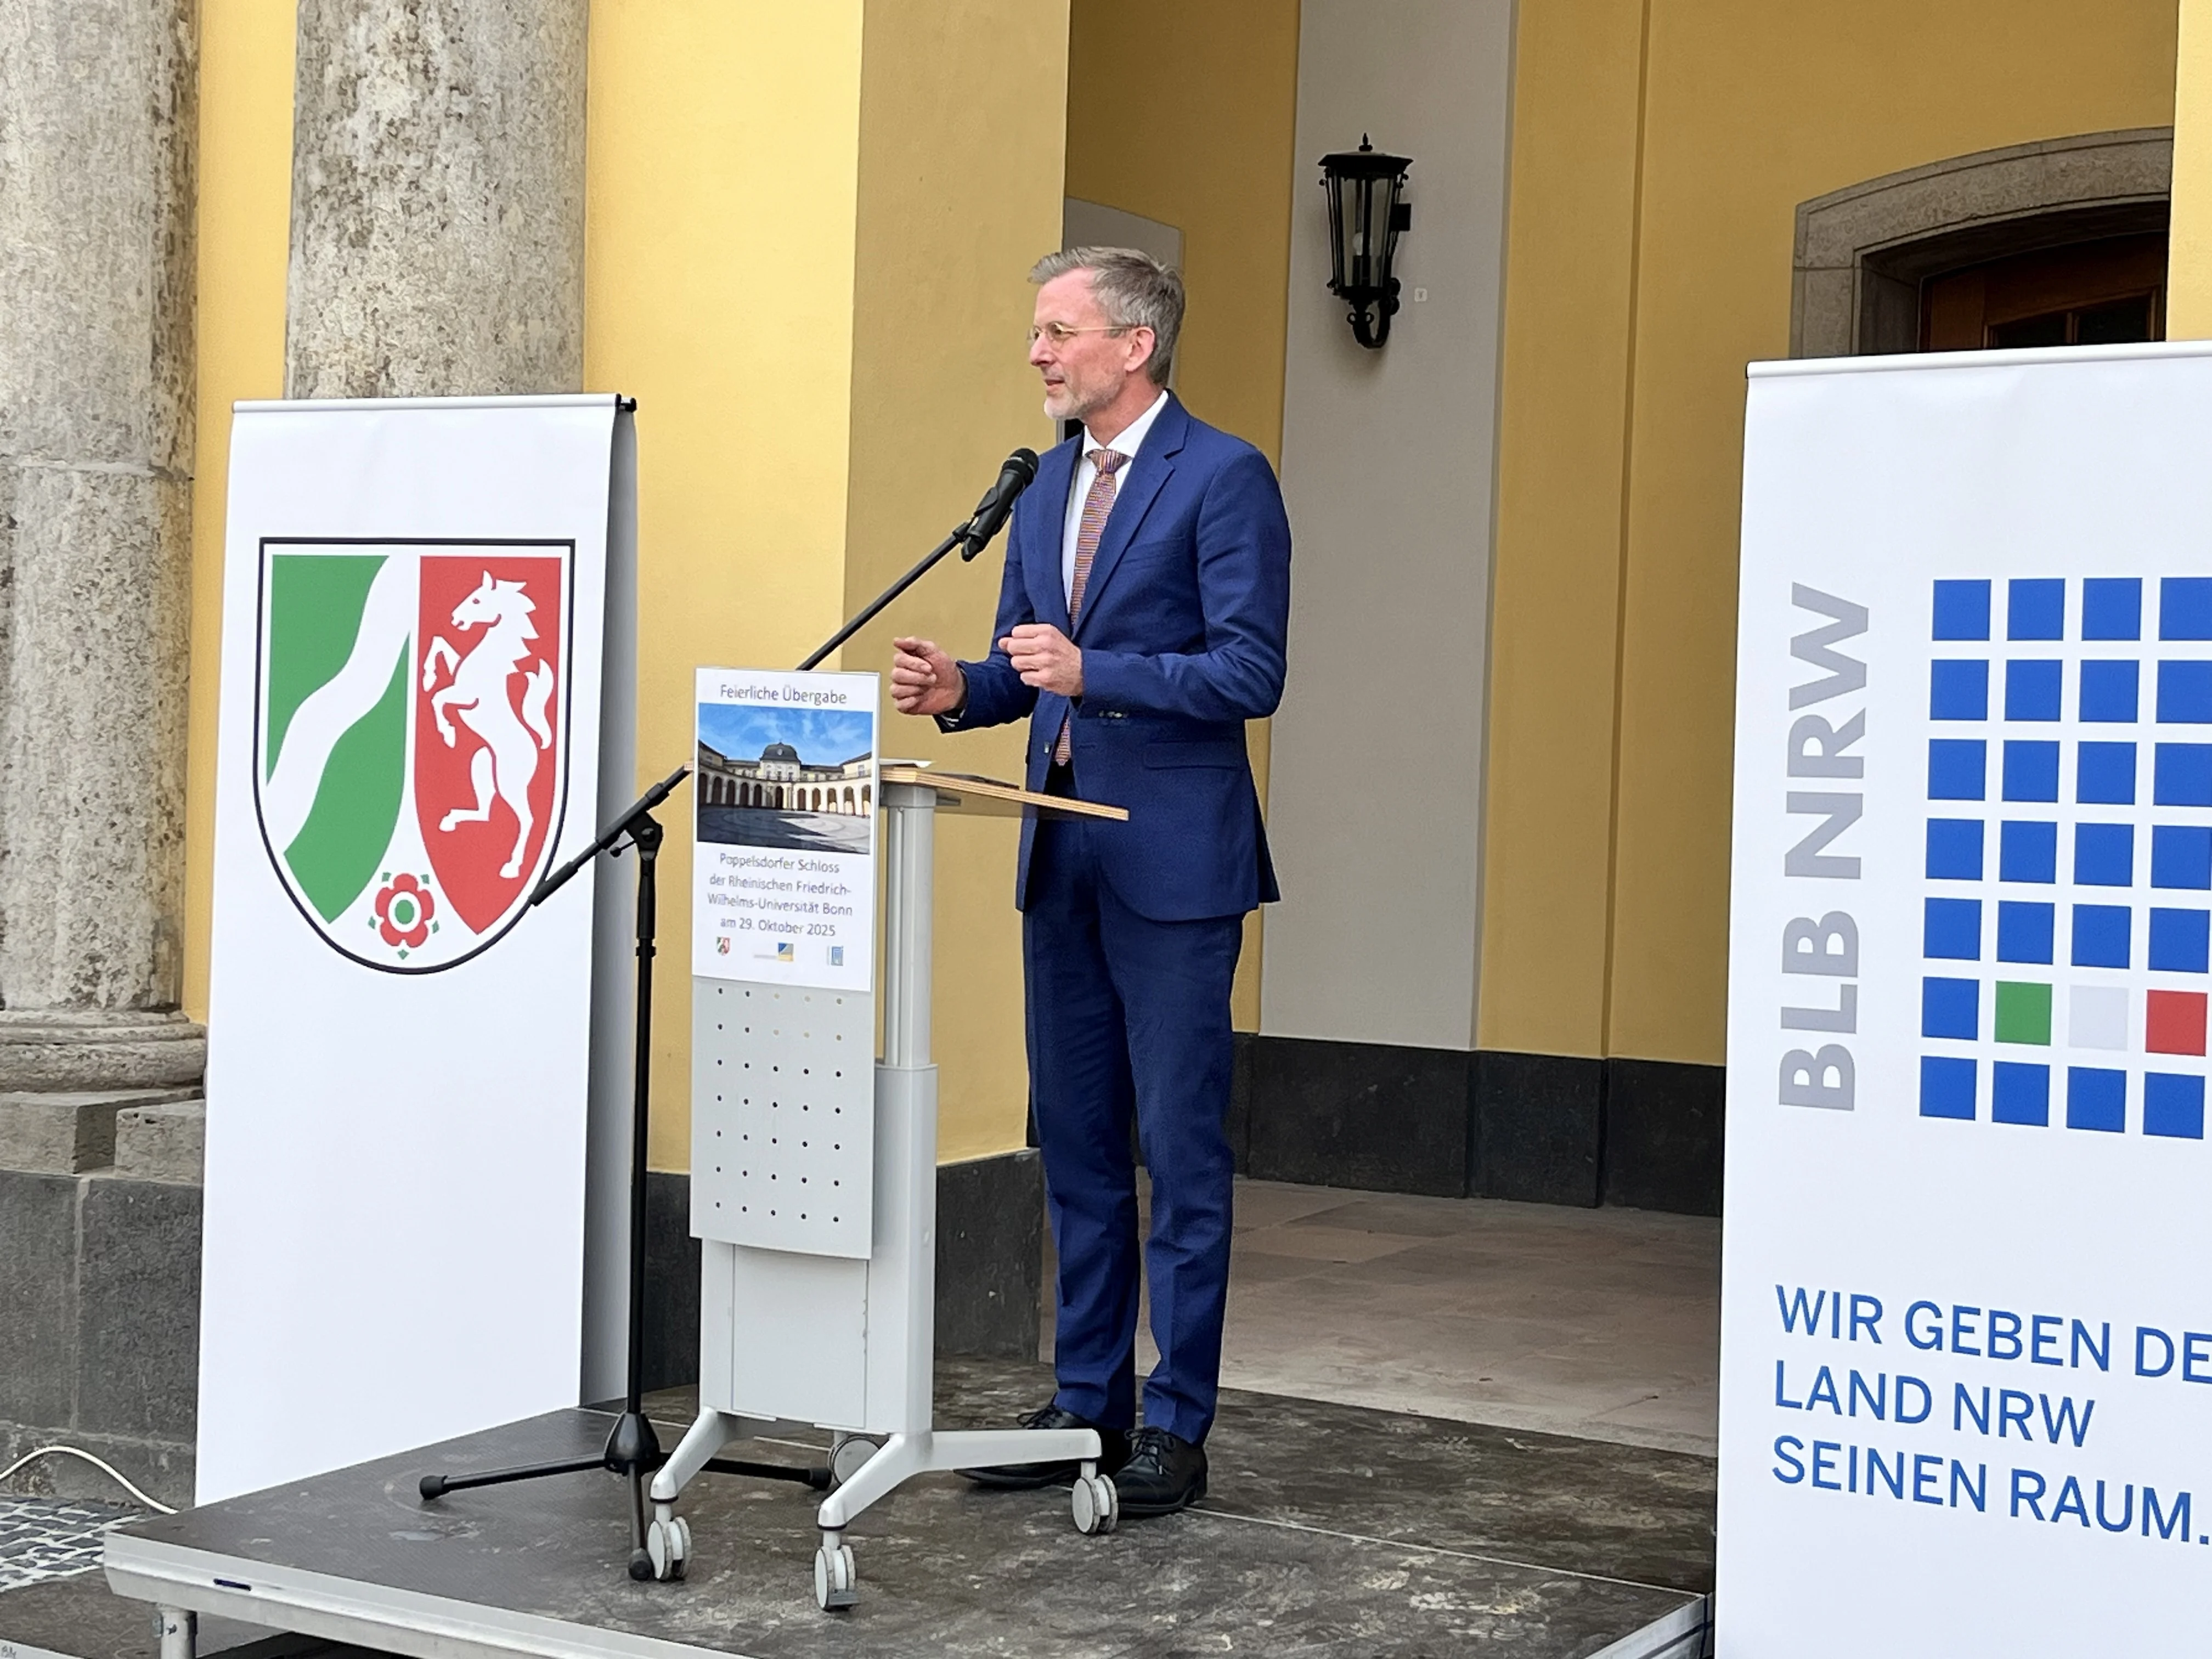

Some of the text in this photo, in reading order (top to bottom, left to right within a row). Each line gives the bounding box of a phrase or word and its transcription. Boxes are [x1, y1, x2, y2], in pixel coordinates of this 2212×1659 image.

[720, 684, 847, 706] Feierliche Übergabe
[1779, 582, 1869, 1111] BLB NRW
[720, 853, 840, 873] Poppelsdorfer Schloss
[709, 873, 852, 895] der Rheinischen Friedrich-
[707, 893, 853, 916] Wilhelms-Universität Bonn
[720, 917, 836, 936] am 29. Oktober 2025
[1776, 1284, 2212, 1384] WIR GEBEN DE
[1775, 1360, 2095, 1447] LAND NRW
[1773, 1435, 2209, 1545] SEINEN RAUM.
